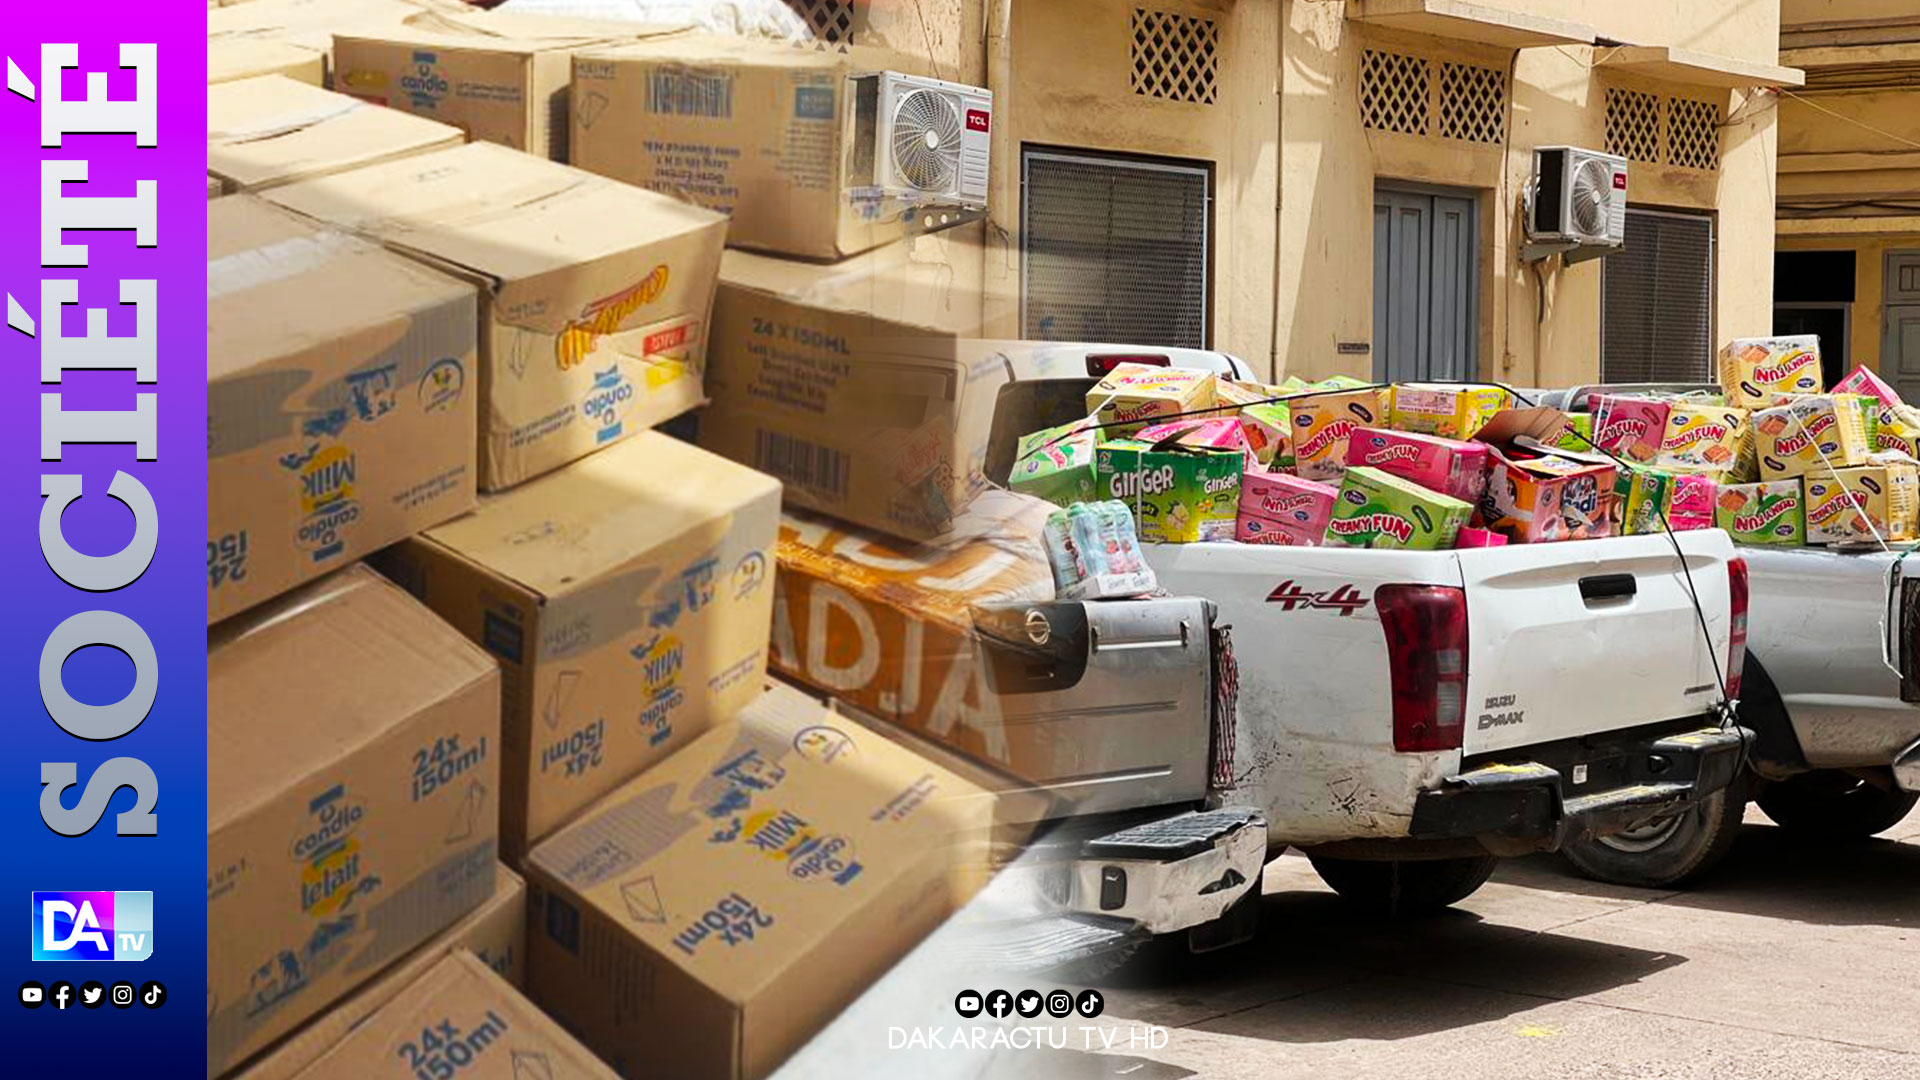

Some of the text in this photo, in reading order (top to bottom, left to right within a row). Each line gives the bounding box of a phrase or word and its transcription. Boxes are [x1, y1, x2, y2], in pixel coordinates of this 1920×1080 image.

[969, 115, 987, 126] TCL
[752, 318, 774, 336] 24
[793, 324, 850, 355] 150ML
[1755, 367, 1786, 383] FUN
[585, 384, 633, 417] candia
[1616, 420, 1647, 438] FUN
[1693, 425, 1727, 442] FUN
[1775, 435, 1808, 456] FUN
[1392, 445, 1419, 462] FUN
[302, 453, 356, 498] Milk
[298, 506, 360, 542] candia
[1330, 516, 1372, 535] CREAMY
[1371, 513, 1414, 544] FUN
[1734, 514, 1765, 532] FUN
[1265, 580, 1371, 616] 4x4
[642, 642, 684, 686] Milk
[640, 691, 684, 727] candia
[1485, 694, 1516, 709] ISUZU
[412, 733, 461, 777] 24x
[541, 718, 605, 773] 150ml
[565, 745, 603, 779] 24x
[413, 737, 487, 802] 150ml
[294, 804, 364, 857] candia
[745, 809, 808, 851] Milk
[793, 837, 847, 879] candia
[672, 892, 751, 956] 150ml
[718, 906, 774, 947] 24x
[398, 1017, 461, 1071] 24x
[416, 1010, 508, 1080] 150ml
